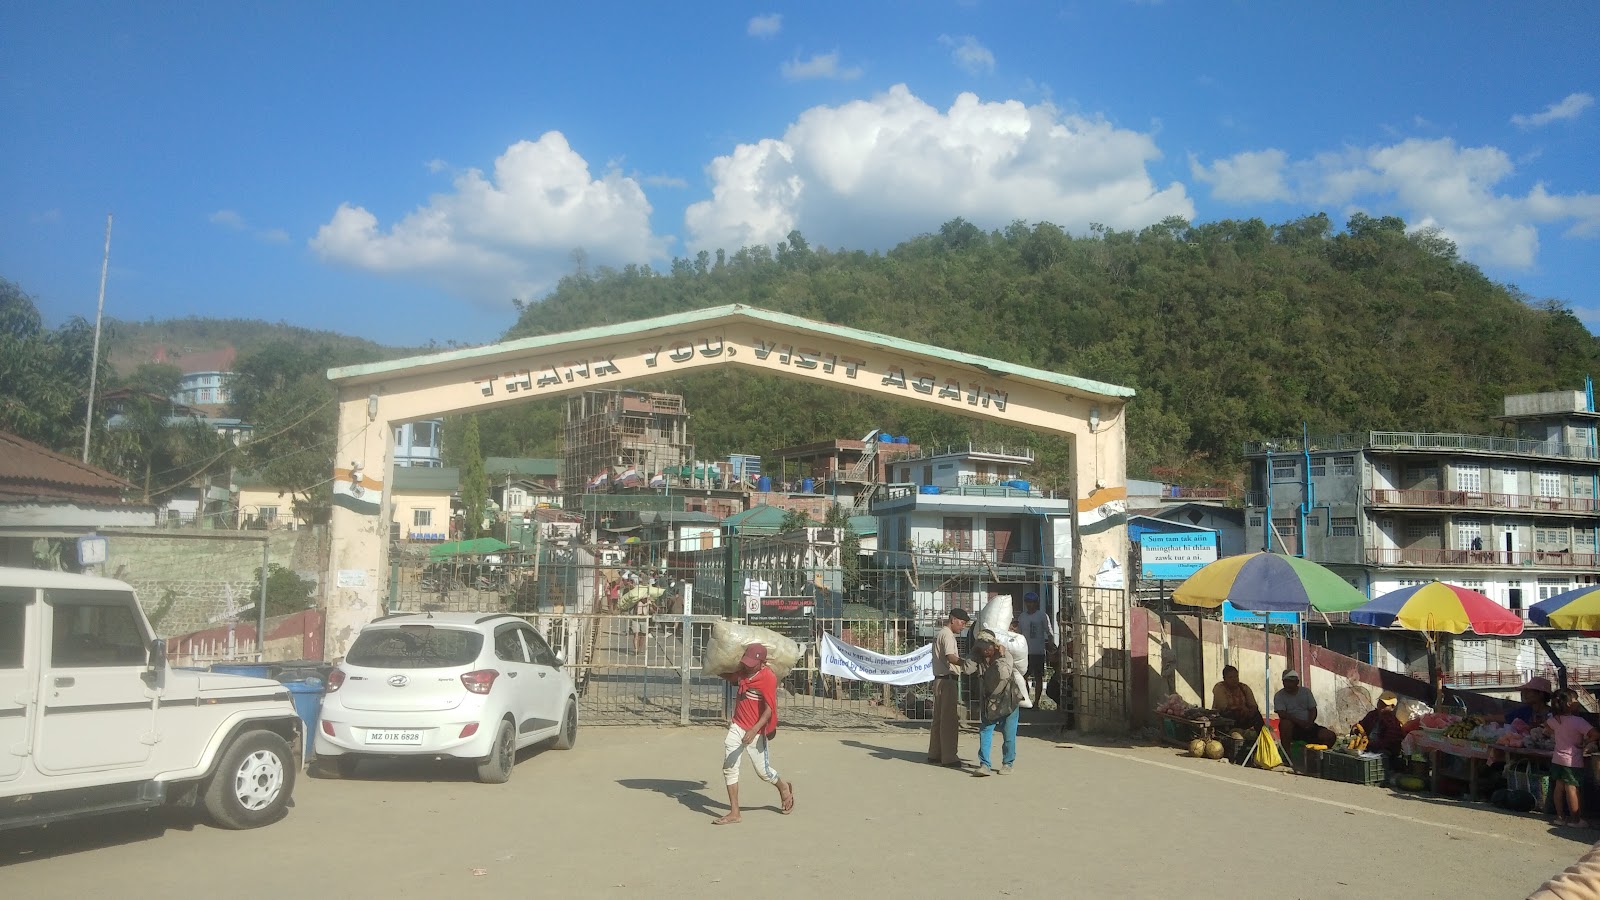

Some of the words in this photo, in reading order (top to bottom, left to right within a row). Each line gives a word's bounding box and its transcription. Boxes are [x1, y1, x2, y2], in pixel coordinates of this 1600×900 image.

[472, 355, 620, 397] THANK
[638, 337, 737, 368] YOU,
[752, 337, 866, 379] VISIT
[881, 364, 1009, 412] AGAIN
[1181, 534, 1192, 542] tak
[1155, 553, 1173, 561] zawk
[850, 661, 858, 672] by
[914, 662, 922, 671] be
[401, 733, 420, 741] 6828
